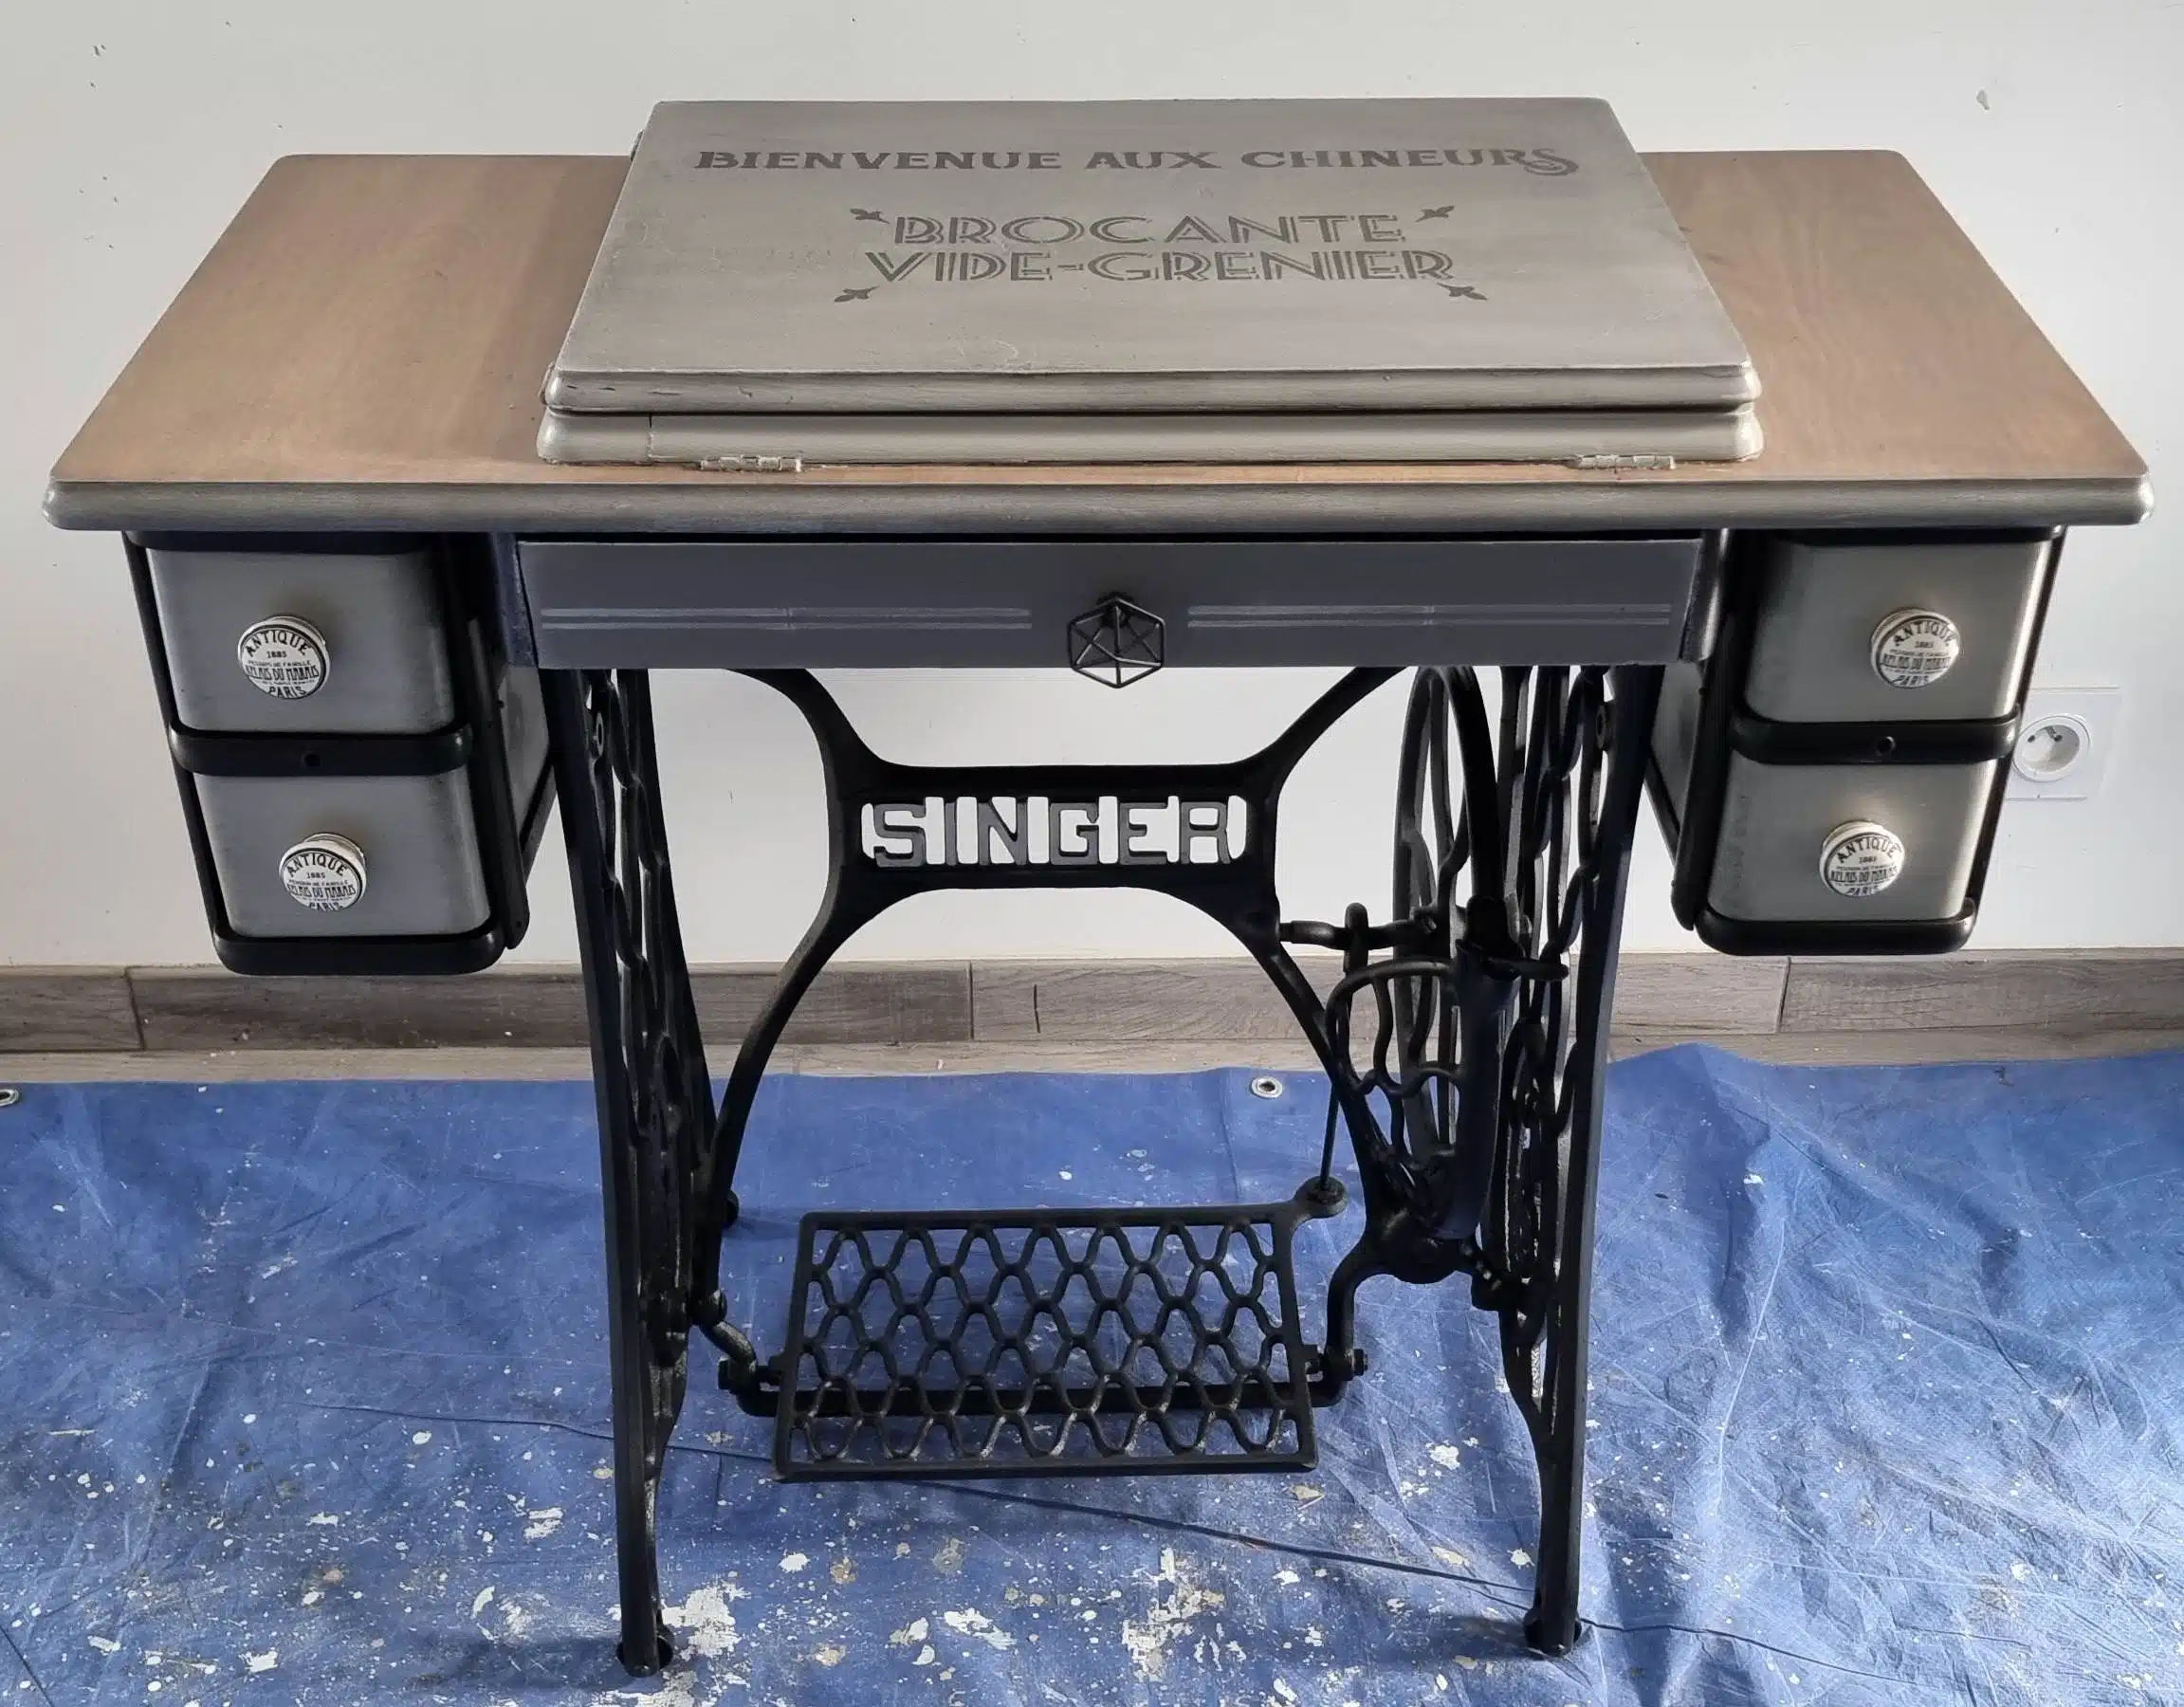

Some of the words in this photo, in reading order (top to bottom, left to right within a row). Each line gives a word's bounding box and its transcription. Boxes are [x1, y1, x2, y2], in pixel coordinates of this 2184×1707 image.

[695, 151, 1061, 169] BIENVENUE
[1084, 151, 1222, 169] AUX
[1241, 148, 1579, 176] CHINEURS
[894, 214, 1405, 245] BROCANTE
[864, 249, 1454, 282] VIDE-GRENIER
[246, 630, 312, 657] ANTIQUE
[1894, 620, 1957, 647] ANTIQUE
[269, 686, 307, 698] PARIS
[873, 802, 1231, 868] SINGER
[1837, 837, 1897, 863] ANTIQUE
[286, 853, 348, 877] ANTIQUE
